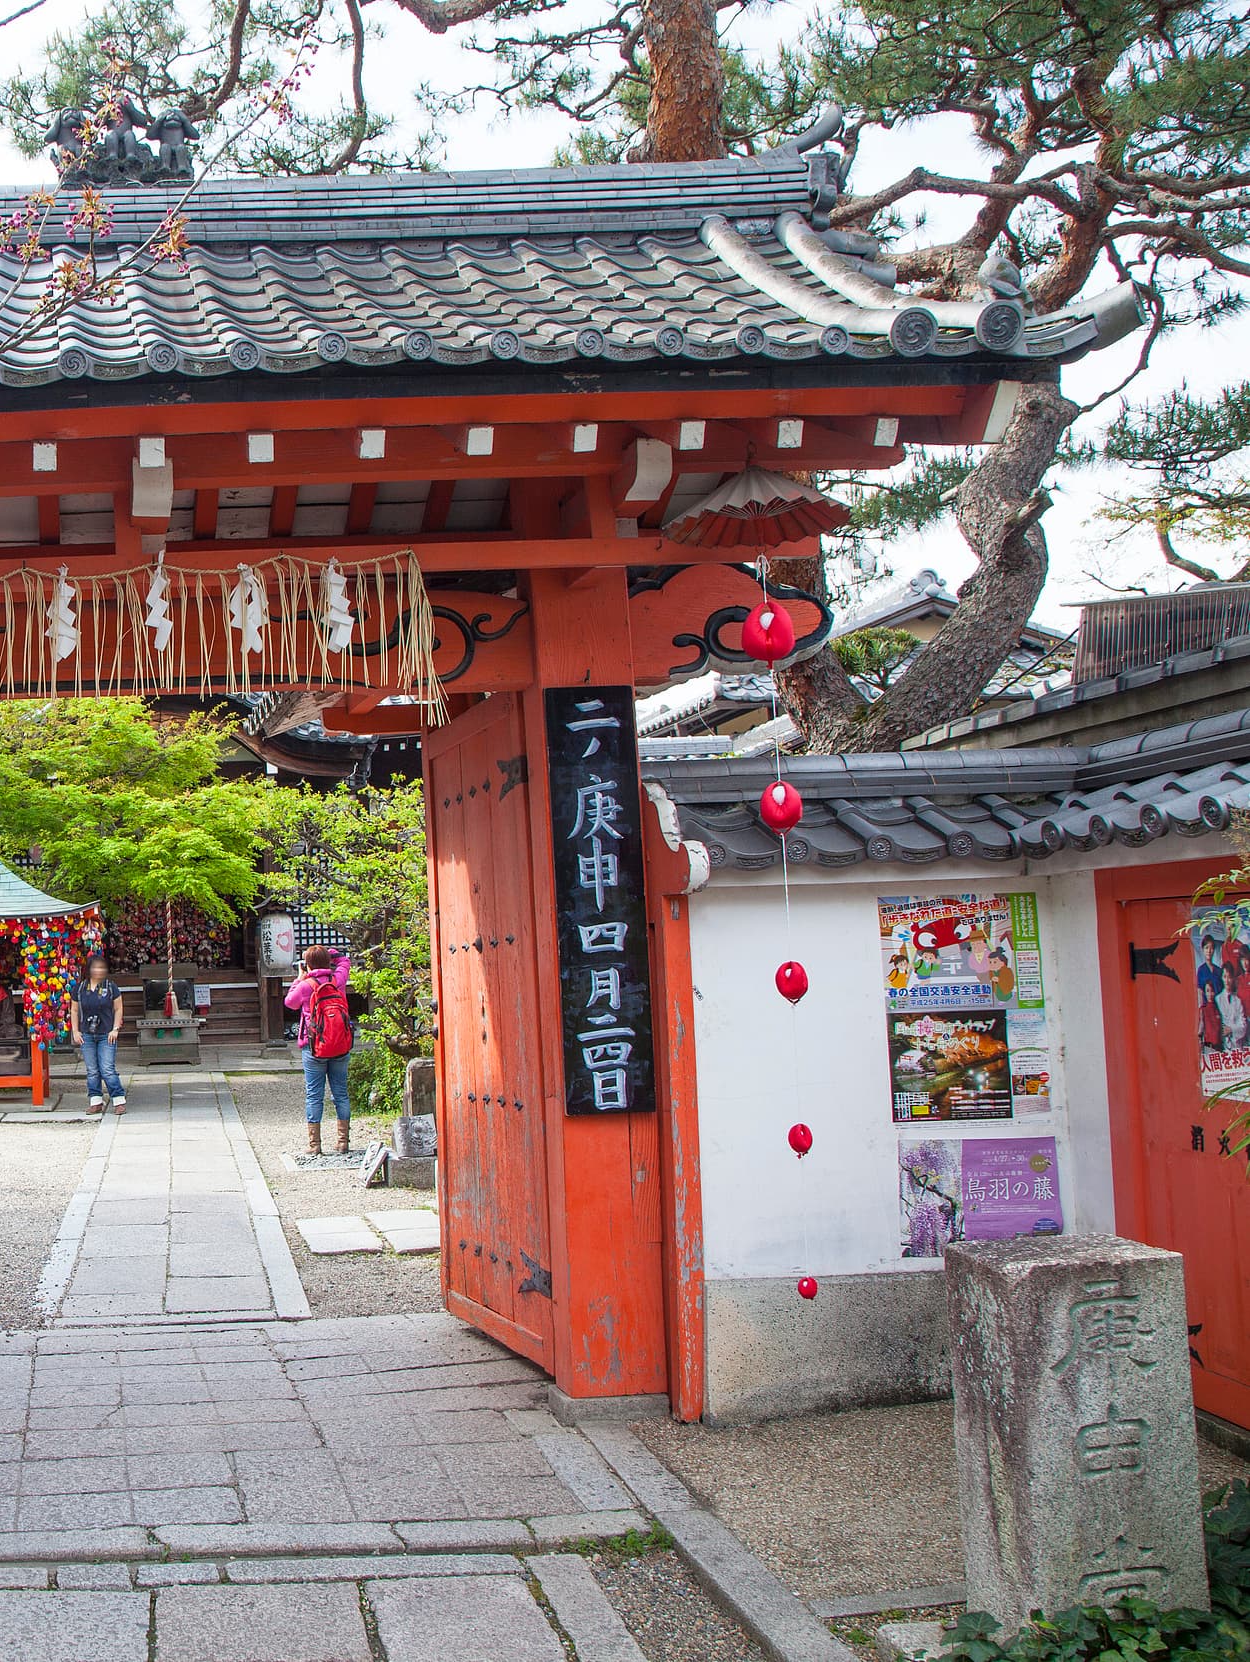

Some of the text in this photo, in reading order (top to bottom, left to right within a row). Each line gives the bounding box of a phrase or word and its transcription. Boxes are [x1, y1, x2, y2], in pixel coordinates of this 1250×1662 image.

[888, 984, 992, 999] 春の全国交通安全運動
[965, 1176, 1055, 1201] 鳥羽の藤
